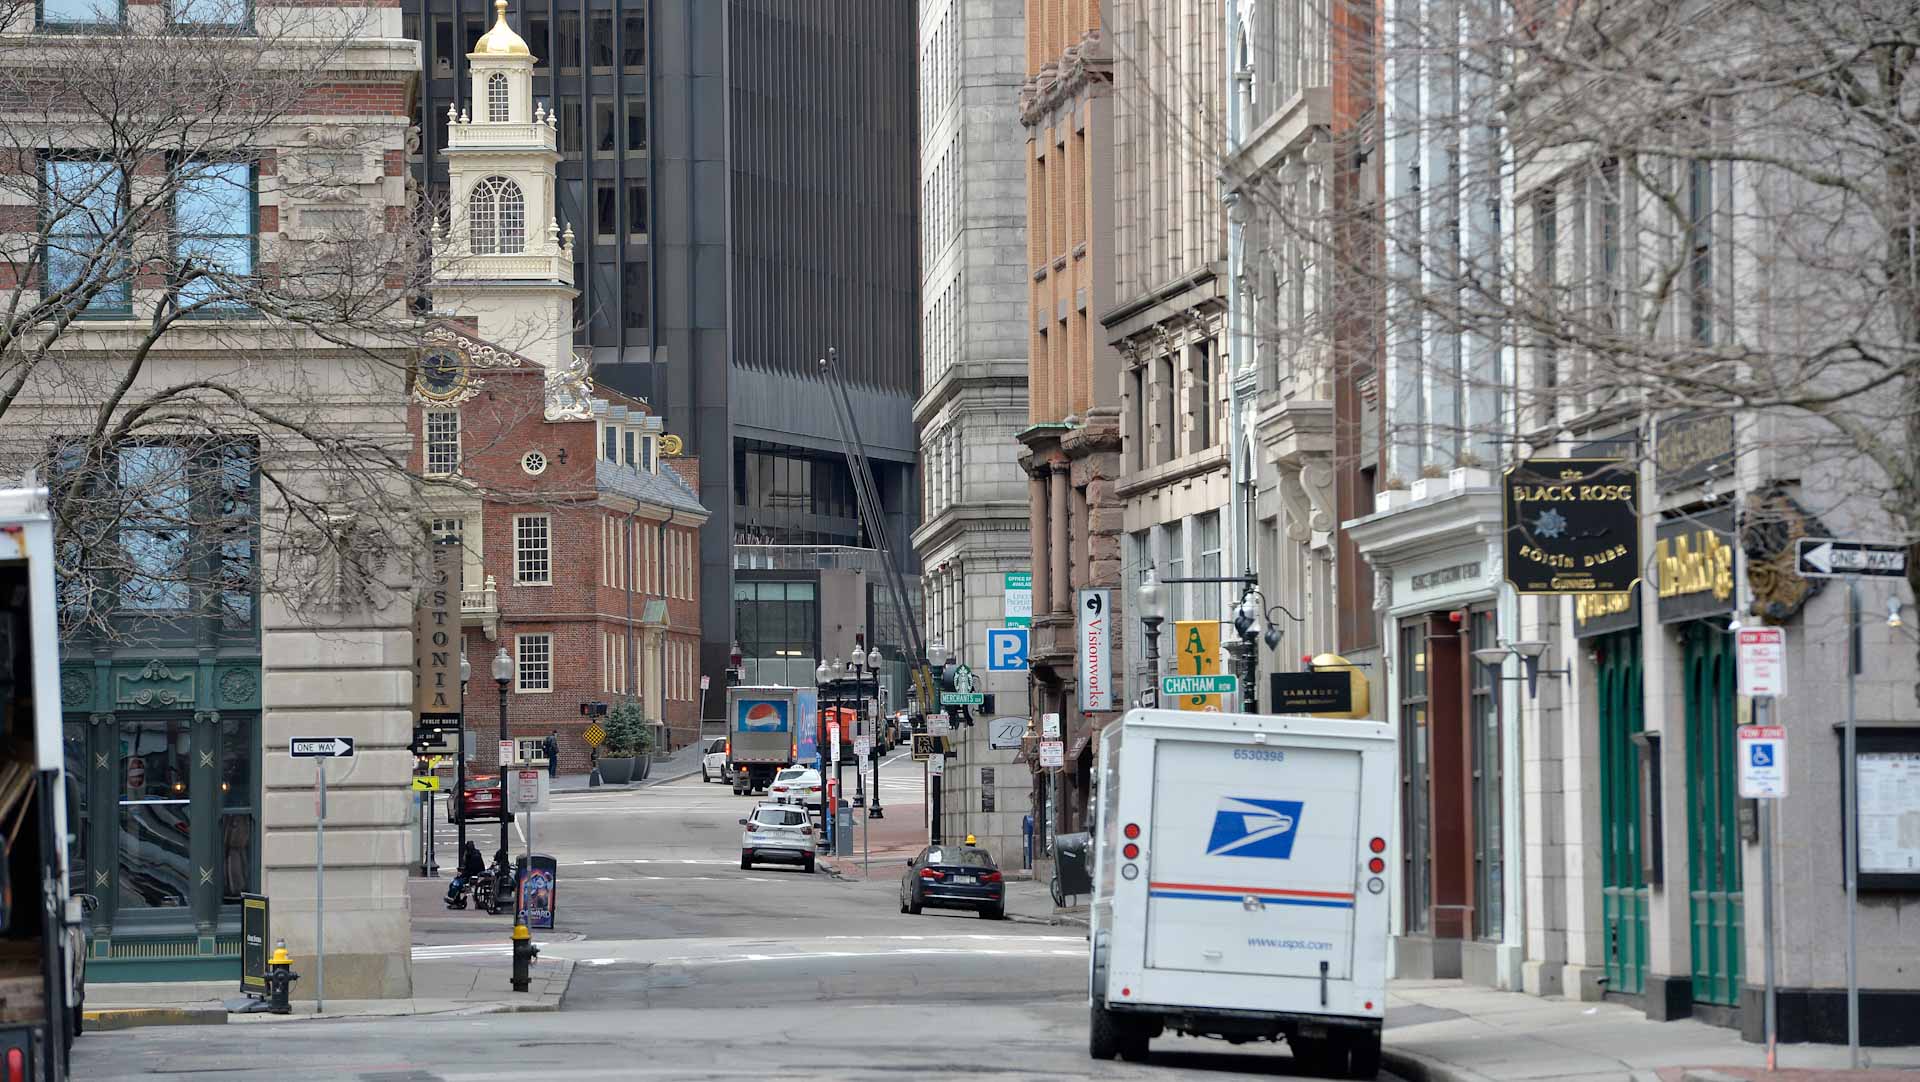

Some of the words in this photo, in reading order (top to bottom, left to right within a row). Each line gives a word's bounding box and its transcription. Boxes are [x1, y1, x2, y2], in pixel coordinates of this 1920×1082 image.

[1513, 485, 1576, 501] BLACK
[1580, 485, 1632, 501] ROSE
[1830, 551, 1858, 565] ONE
[1868, 553, 1897, 566] WAY
[994, 634, 1021, 666] P
[1088, 619, 1104, 707] Visionworks
[1166, 678, 1215, 693] CHATHAM
[942, 694, 974, 703] MERCHANTS
[297, 743, 314, 752] ONE
[318, 743, 335, 752] WAY
[1233, 749, 1285, 762] 6530398
[1247, 937, 1333, 951] www.usps.com
